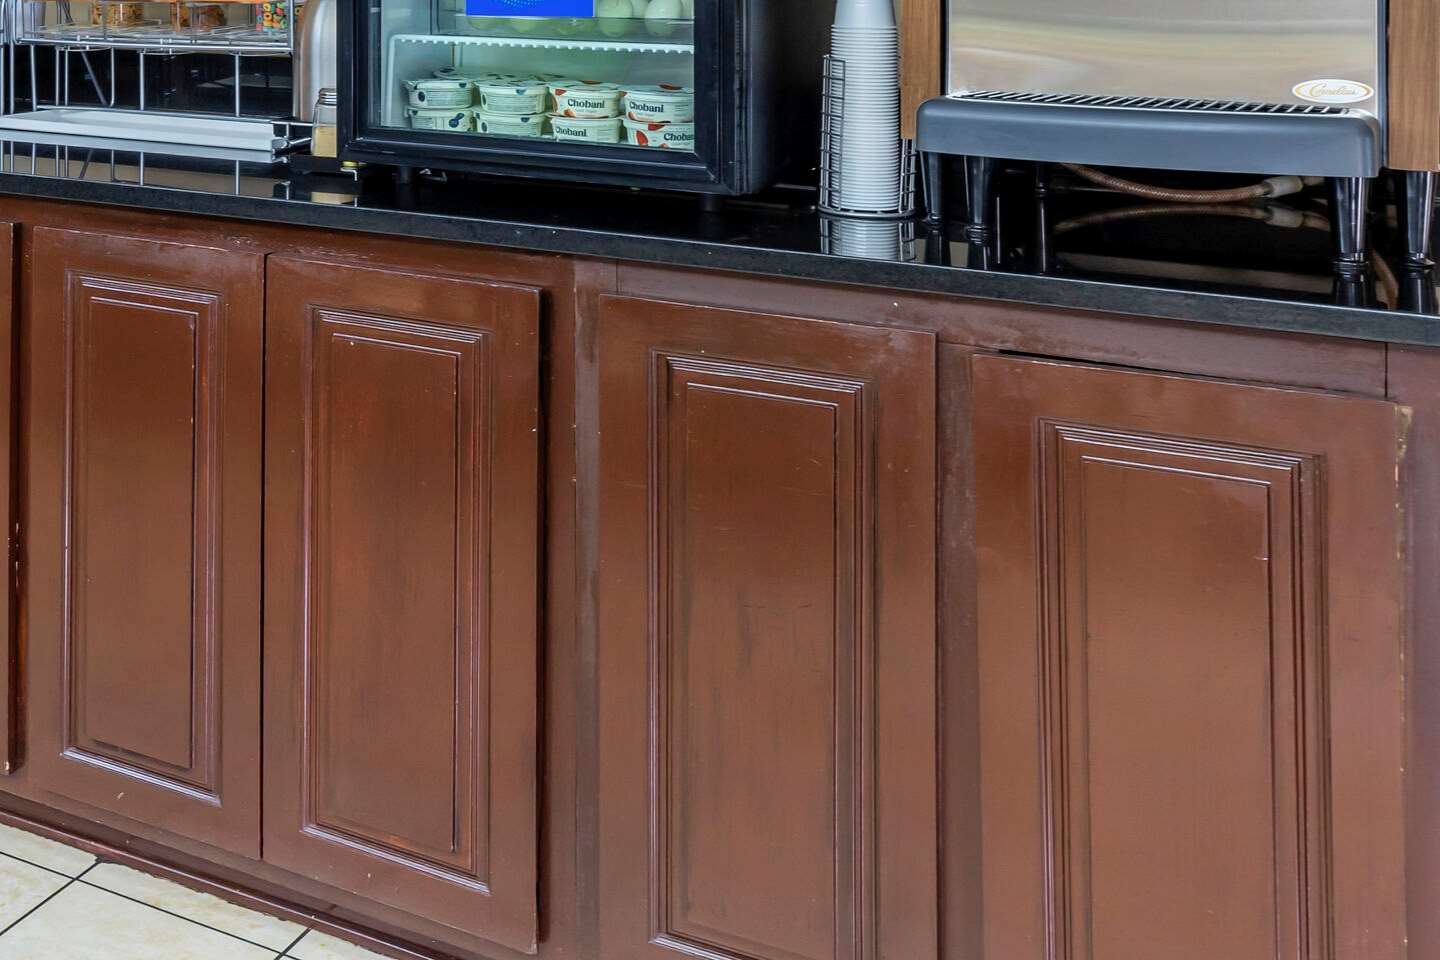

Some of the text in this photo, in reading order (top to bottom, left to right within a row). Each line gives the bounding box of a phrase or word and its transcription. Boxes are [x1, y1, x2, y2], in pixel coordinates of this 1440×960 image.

[567, 98, 605, 109] Chobani
[629, 101, 664, 113] Chobani
[555, 126, 587, 138] Chobani
[663, 132, 693, 142] Choba
